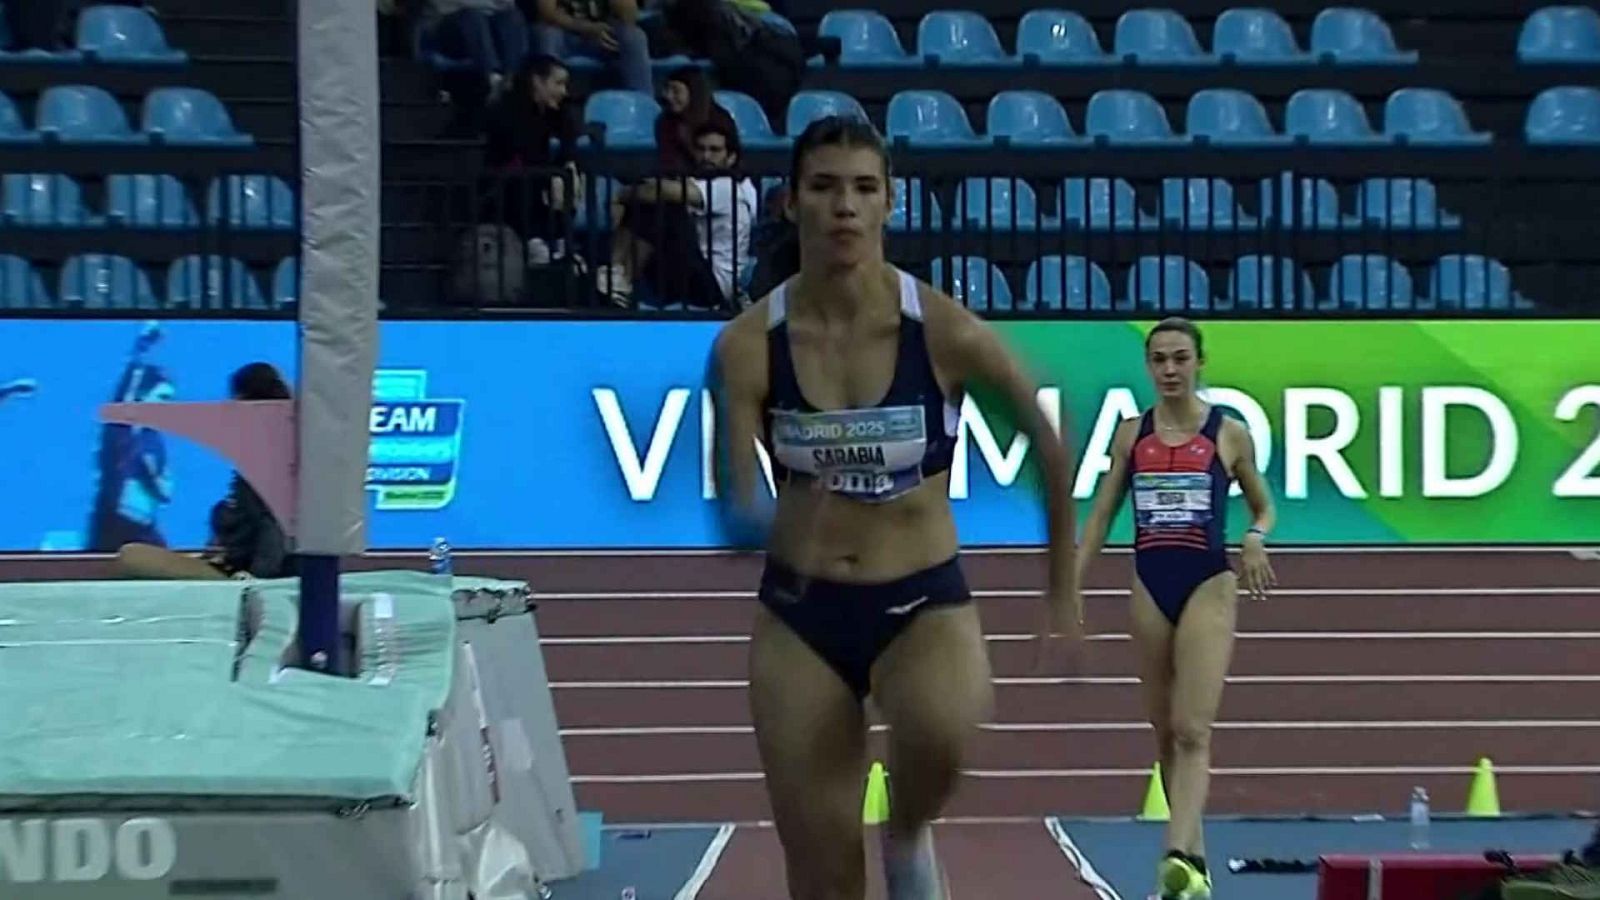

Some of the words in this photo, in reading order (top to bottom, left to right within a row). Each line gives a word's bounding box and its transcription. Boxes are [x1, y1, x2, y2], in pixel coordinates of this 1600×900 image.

[369, 406, 437, 432] EAM
[846, 420, 885, 438] 2025
[949, 386, 1519, 498] MADRID
[1552, 384, 1600, 497] 2
[812, 444, 886, 468] SARABIA
[827, 471, 894, 494] oma
[0, 817, 177, 882] NDO
